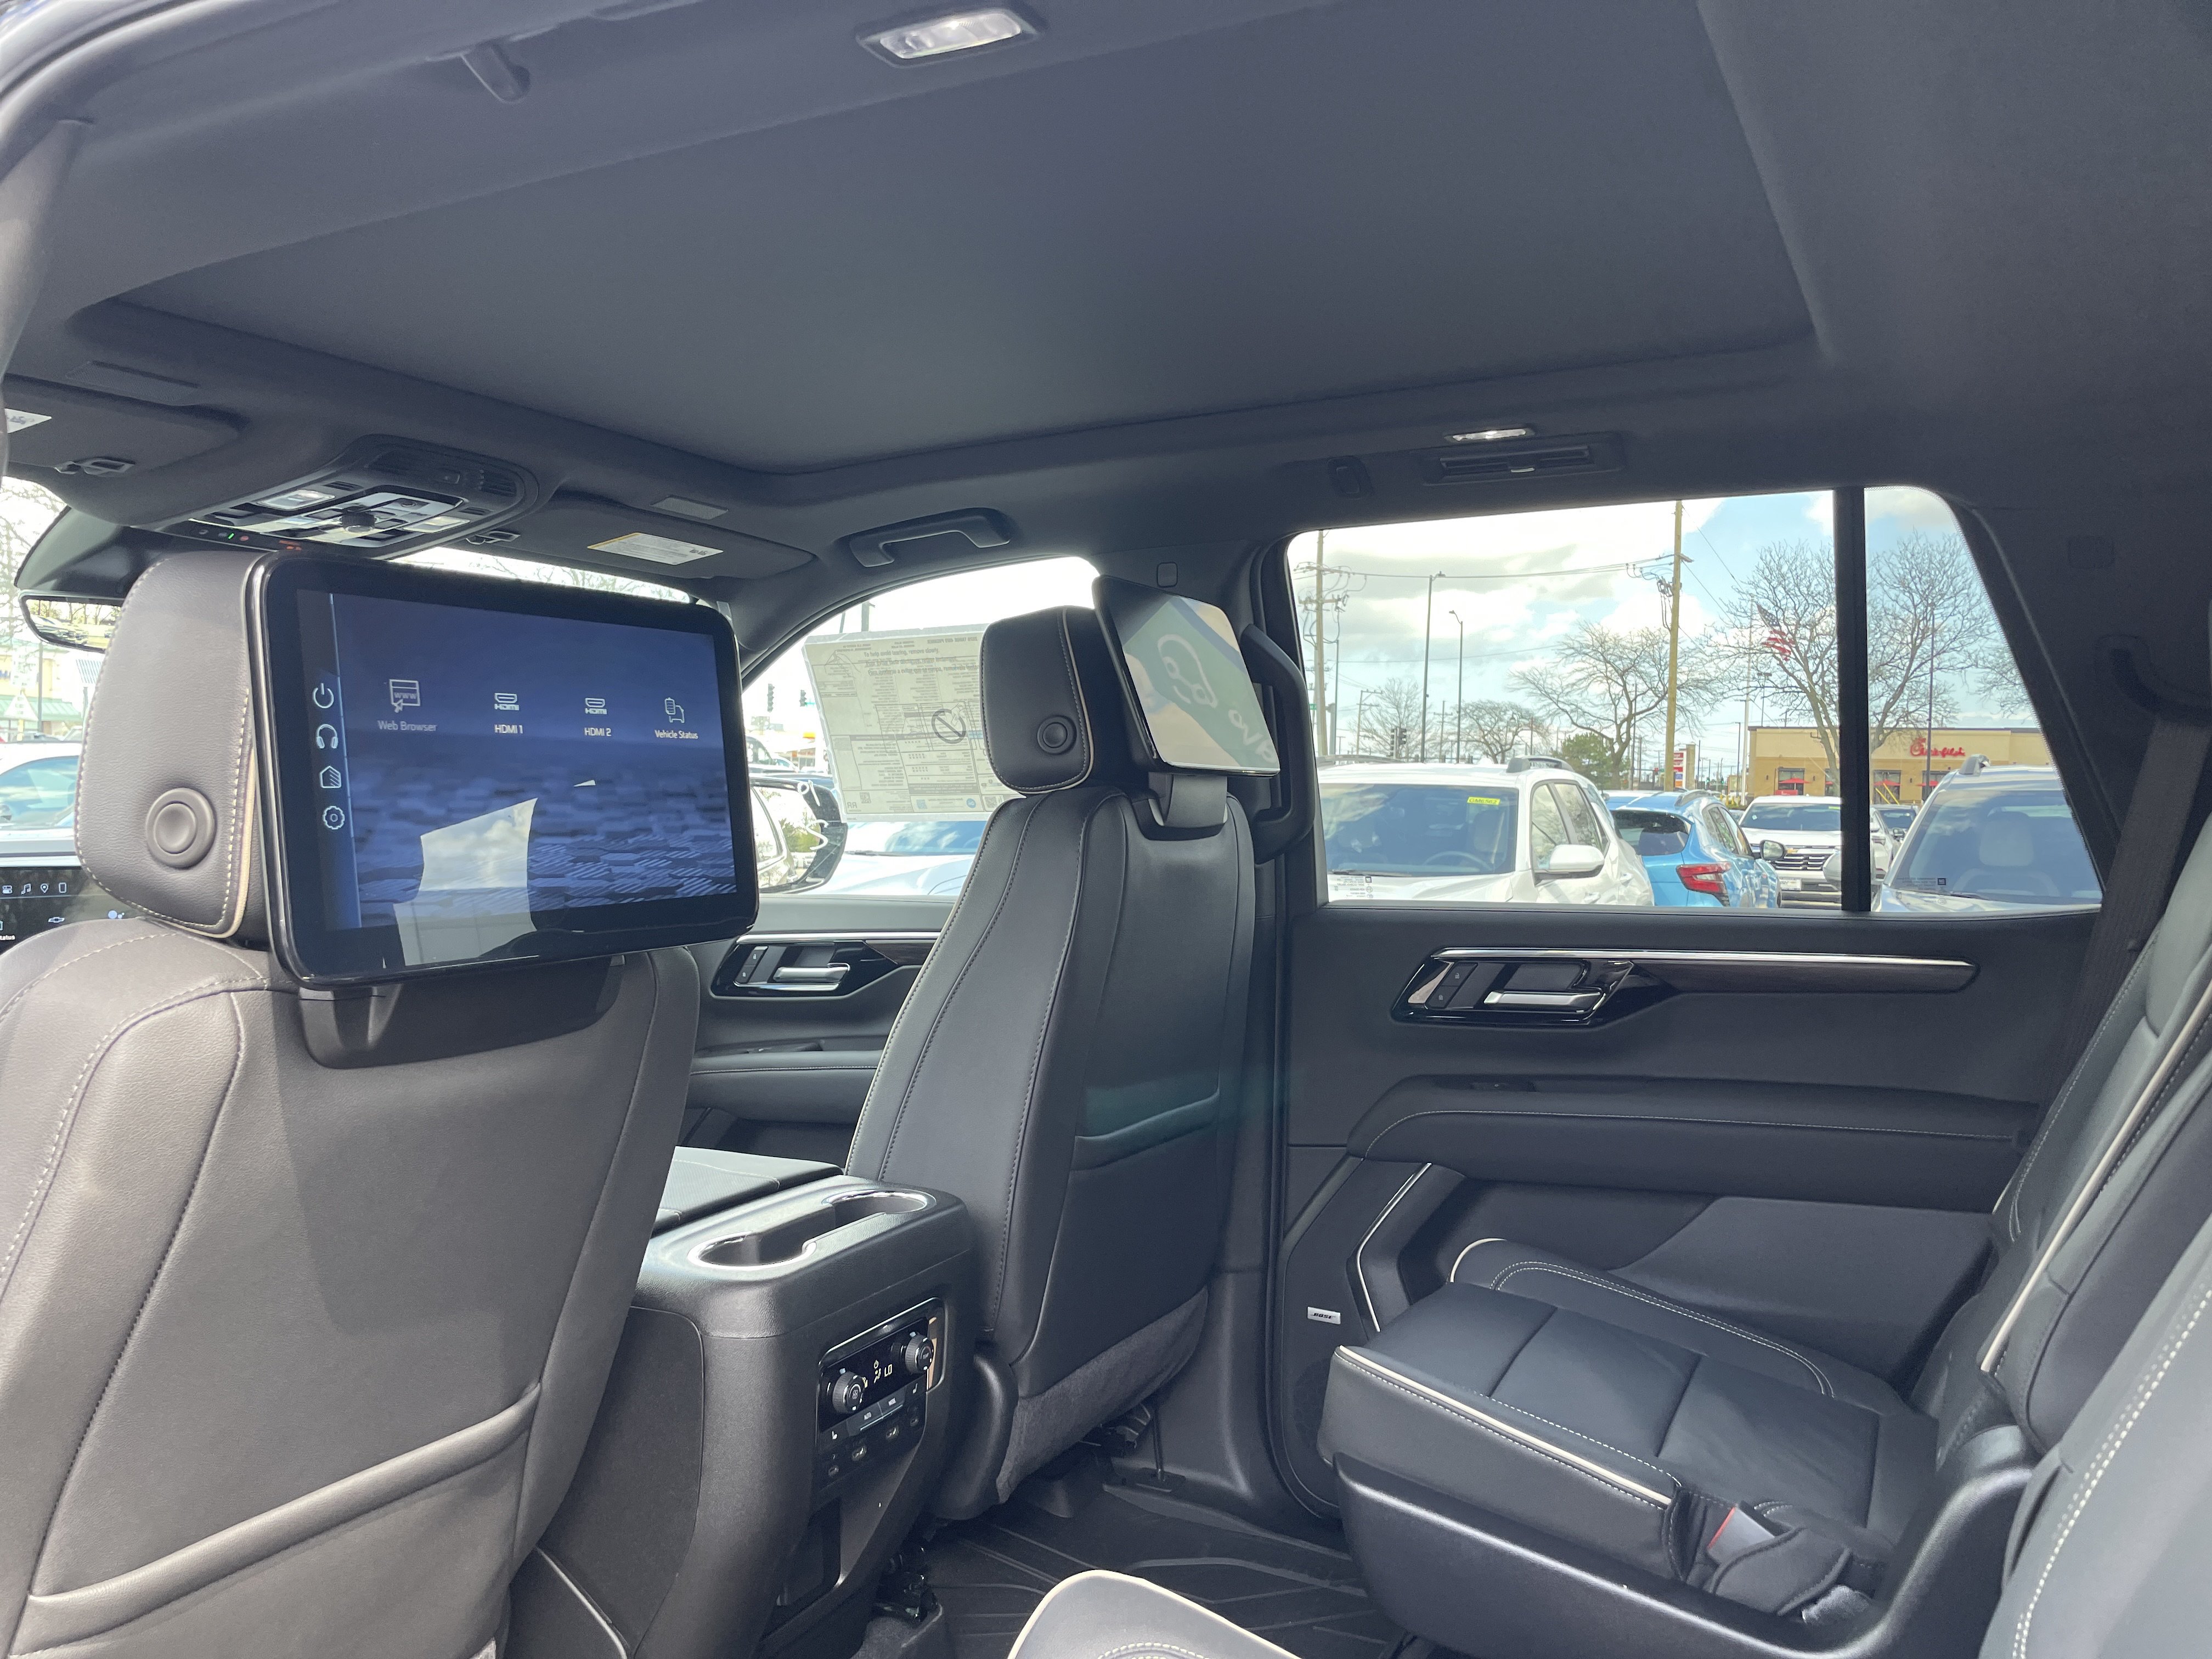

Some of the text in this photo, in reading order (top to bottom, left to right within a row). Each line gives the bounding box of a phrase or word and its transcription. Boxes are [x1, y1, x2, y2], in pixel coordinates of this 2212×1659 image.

[377, 720, 438, 731] Web Browser
[494, 724, 523, 734] HDMI 1
[584, 727, 612, 737] HDMI 2
[654, 729, 699, 740] Vehicle Status
